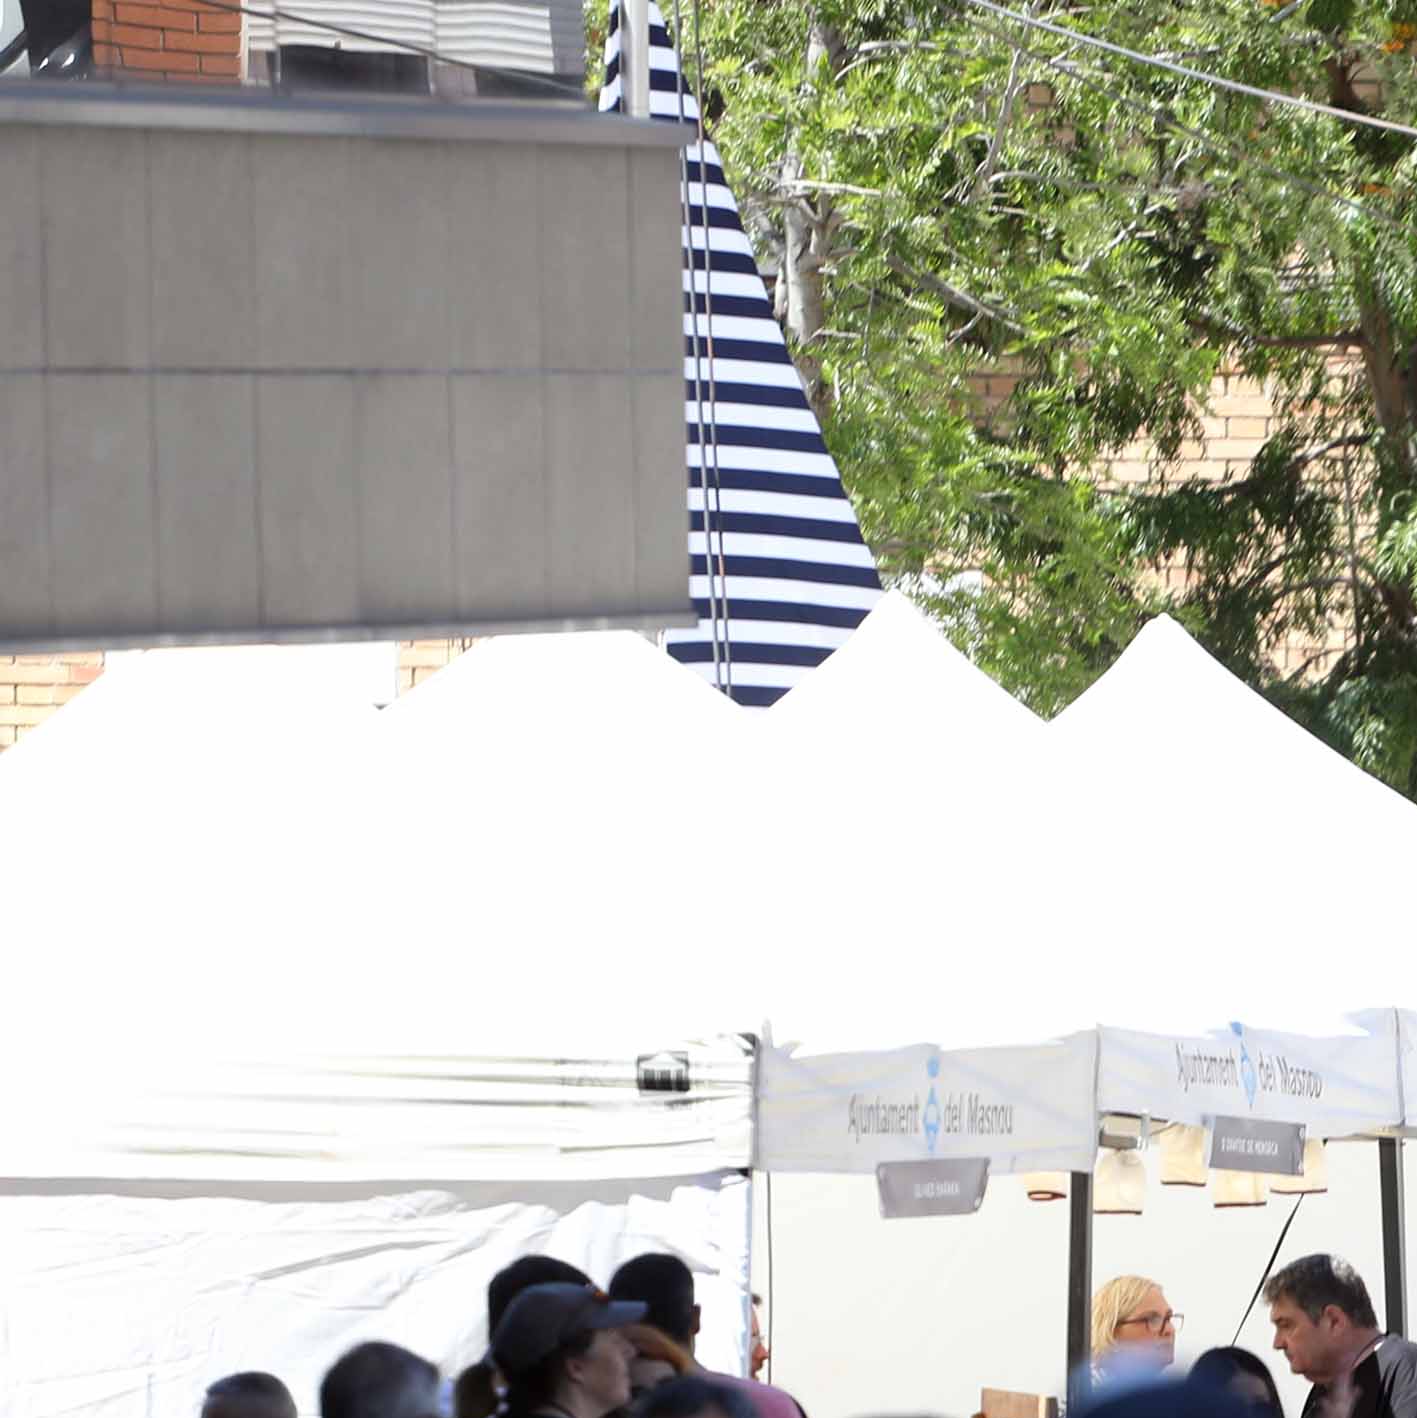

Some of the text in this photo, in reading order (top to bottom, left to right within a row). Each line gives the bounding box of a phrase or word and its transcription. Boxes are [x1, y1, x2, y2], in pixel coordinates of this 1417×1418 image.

[1175, 1042, 1323, 1100] Ajuntament del Masnou
[848, 1090, 1014, 1144] Ajuntament del Masnou
